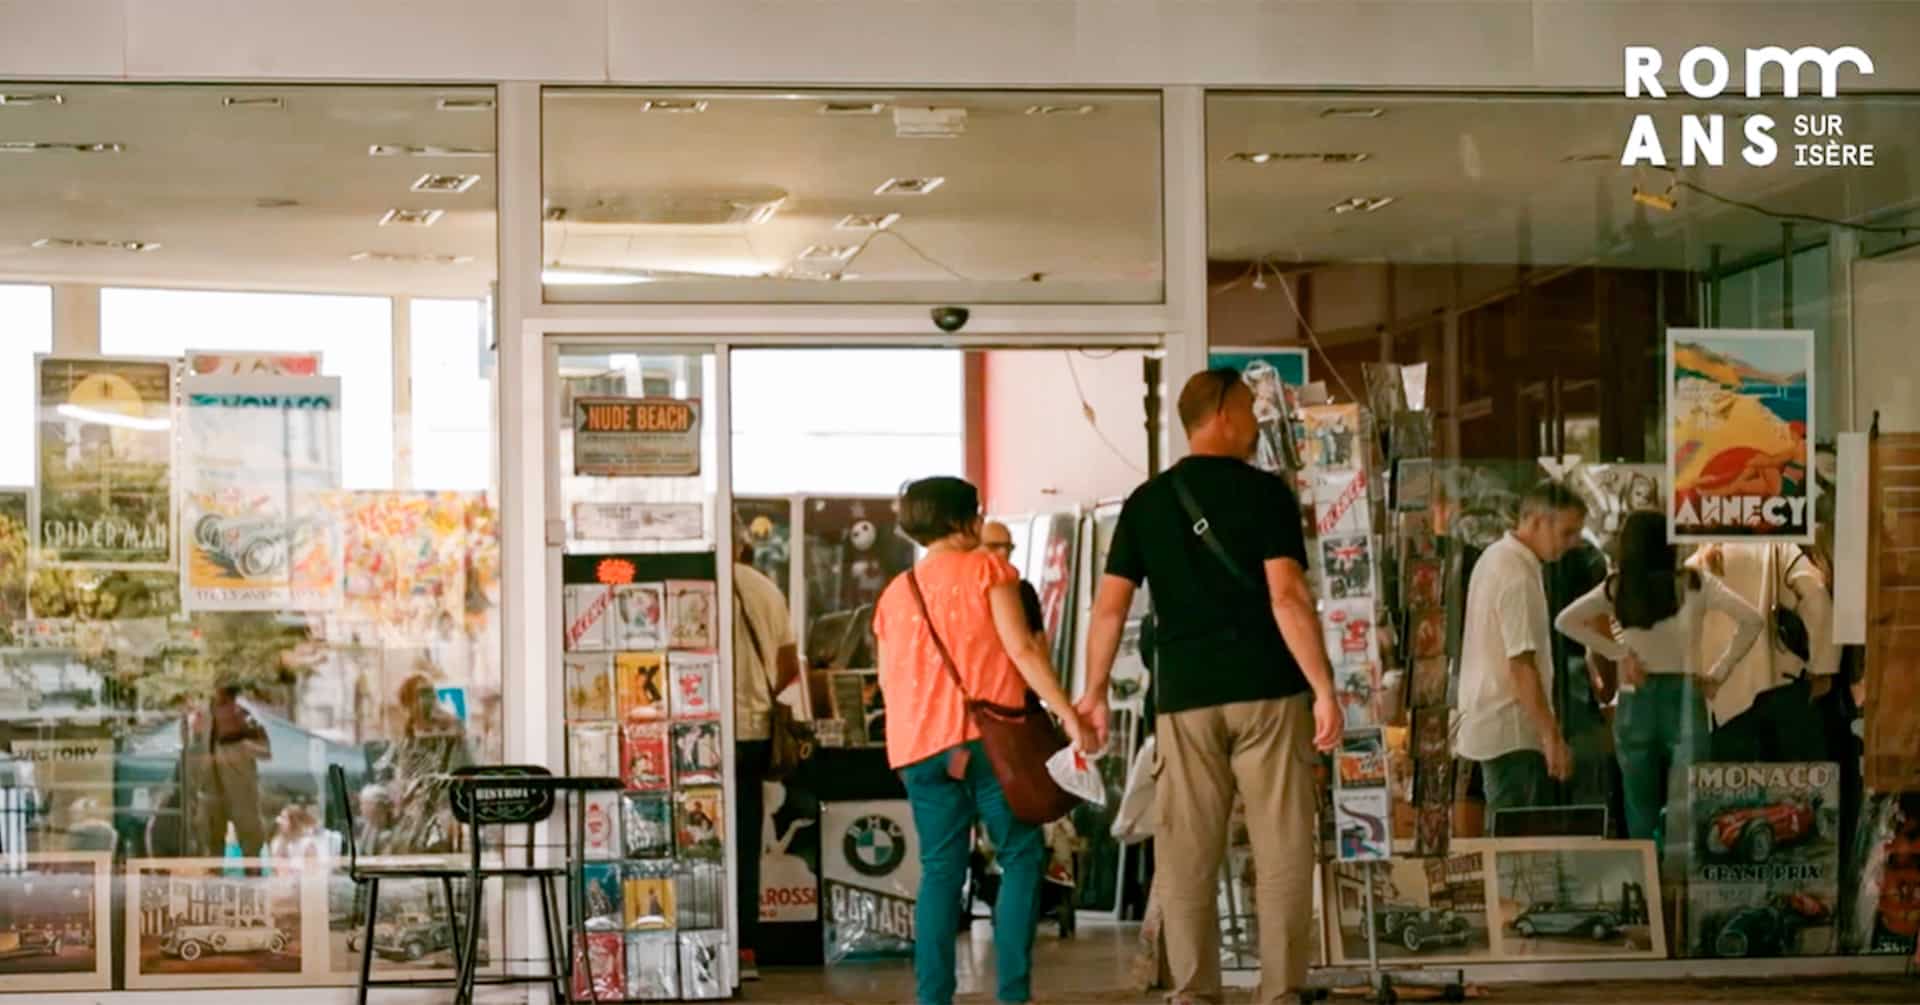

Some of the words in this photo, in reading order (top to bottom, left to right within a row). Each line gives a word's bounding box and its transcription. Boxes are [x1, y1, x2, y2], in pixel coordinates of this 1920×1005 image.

[588, 406, 630, 429] NUDE
[636, 406, 687, 430] BEACH
[1676, 496, 1805, 526] ANNECY
[1697, 768, 1829, 789] MONACO
[1774, 864, 1822, 881] PRIX
